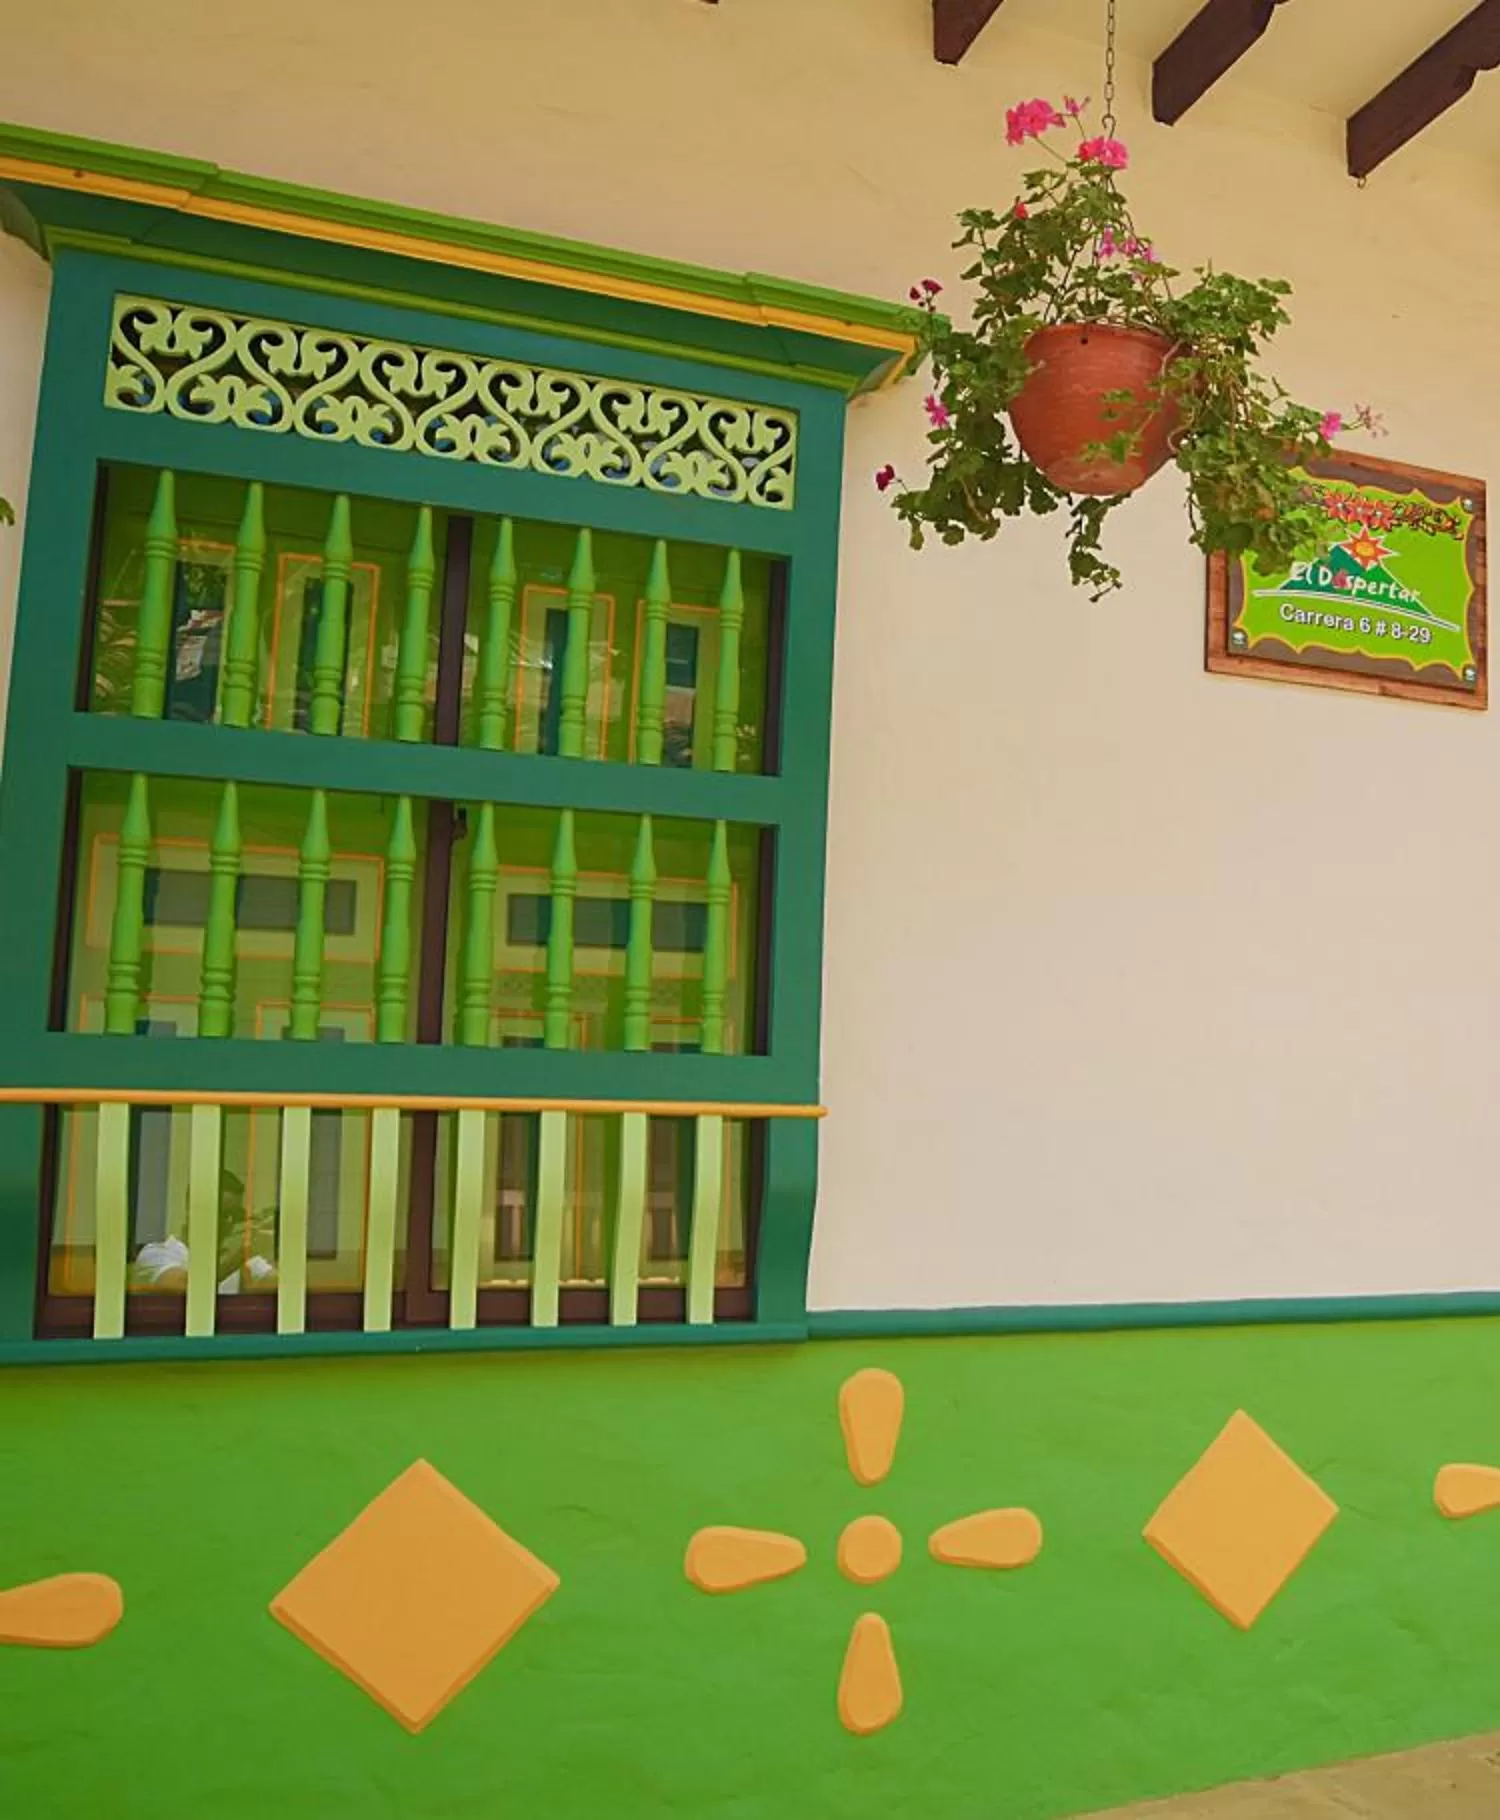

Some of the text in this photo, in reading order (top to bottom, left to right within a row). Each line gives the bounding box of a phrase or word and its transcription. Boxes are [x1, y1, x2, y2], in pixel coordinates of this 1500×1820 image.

[1291, 561, 1312, 585] El
[1281, 603, 1431, 643] Carrera 6 # 8-29
